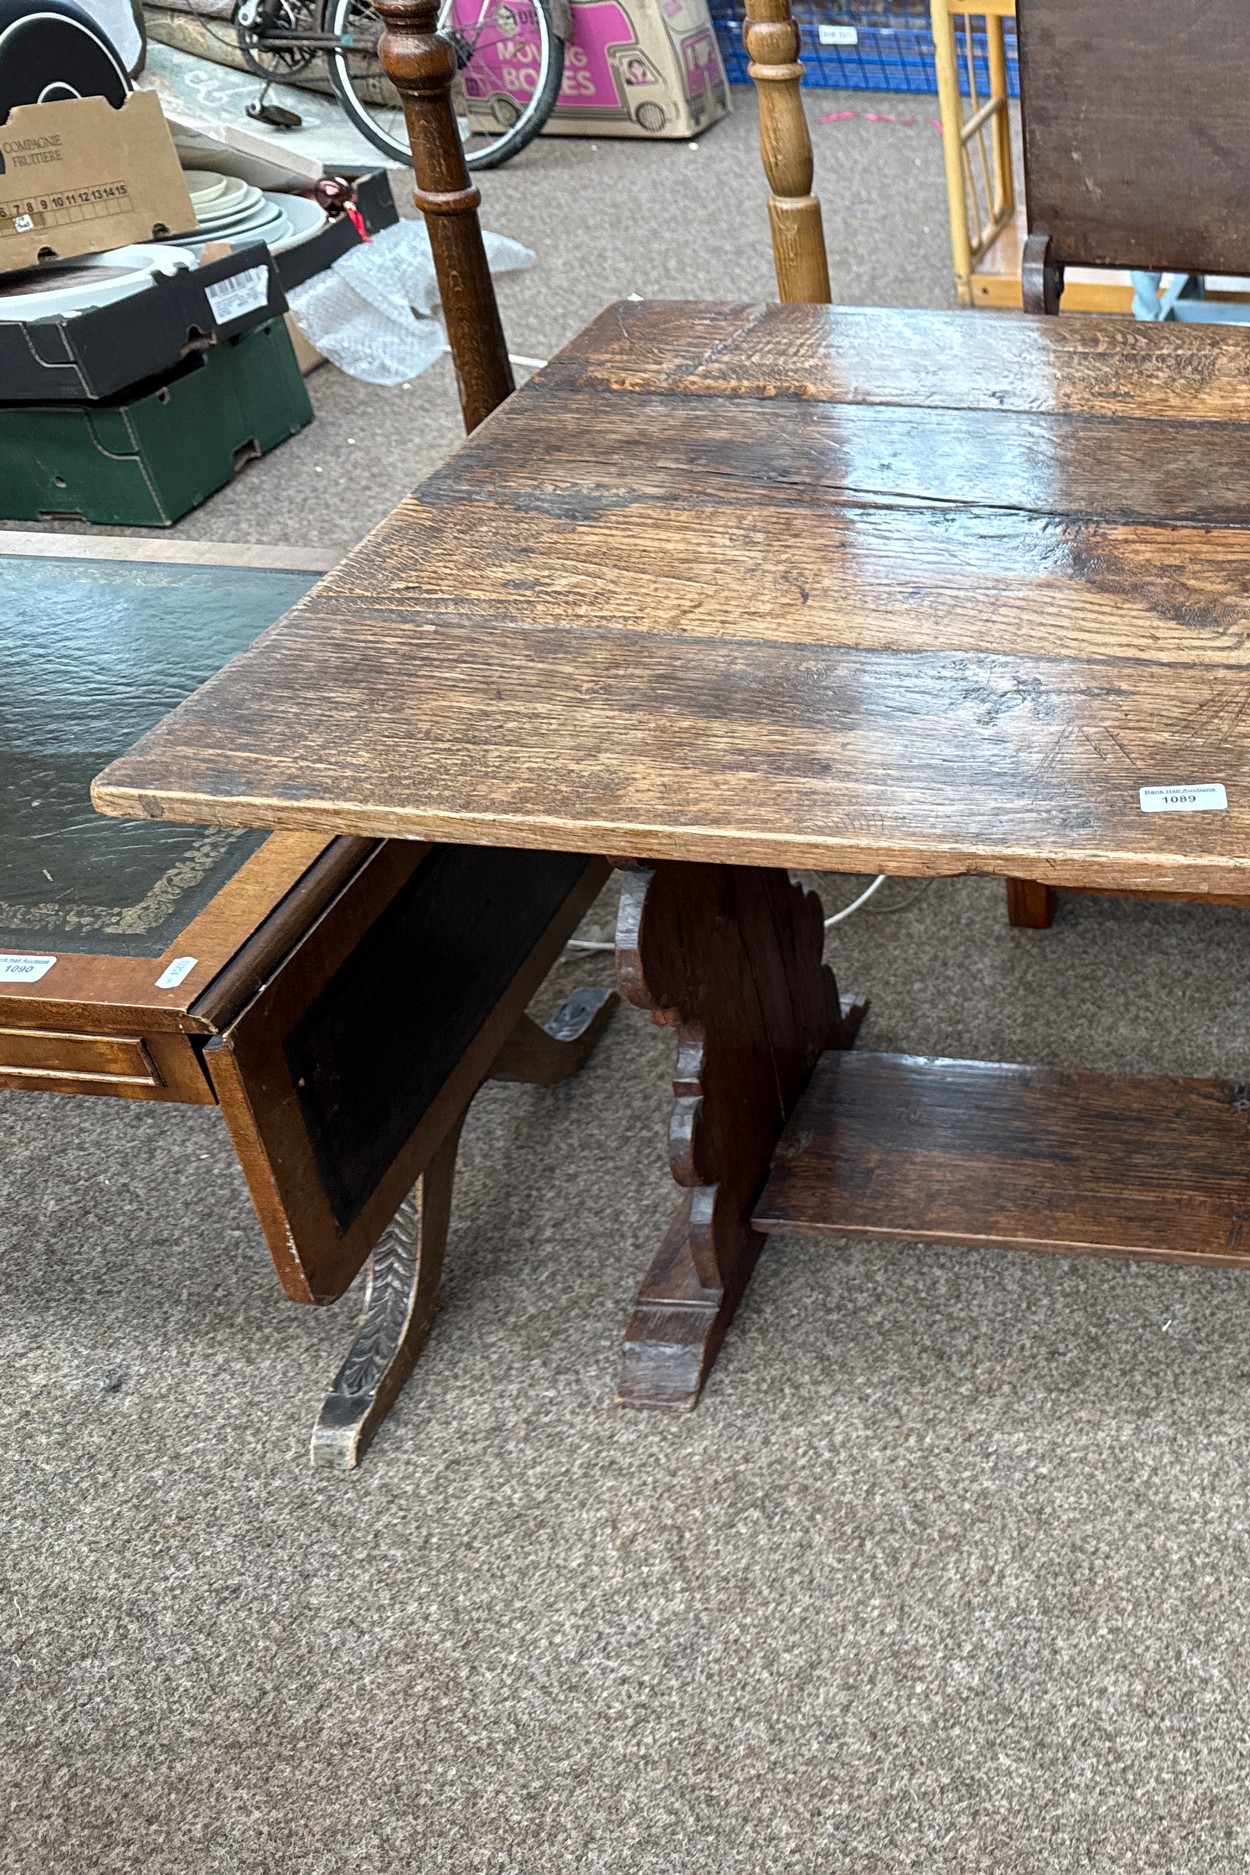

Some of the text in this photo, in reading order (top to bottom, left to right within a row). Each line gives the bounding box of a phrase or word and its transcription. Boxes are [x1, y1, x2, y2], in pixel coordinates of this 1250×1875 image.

[503, 67, 597, 96] BOES
[2, 134, 63, 154] COMPAGNIE
[12, 150, 63, 168] FRUITIERE
[13, 204, 20, 214] 7
[26, 202, 34, 213] 8
[40, 199, 48, 210] 9
[52, 196, 64, 208] 10
[65, 194, 77, 205] 11
[79, 191, 90, 202] 12
[91, 189, 103, 200] 13
[103, 186, 115, 197] 14
[115, 184, 127, 195] 15
[1162, 795, 1196, 804] 1089
[5, 964, 34, 973] 1090
